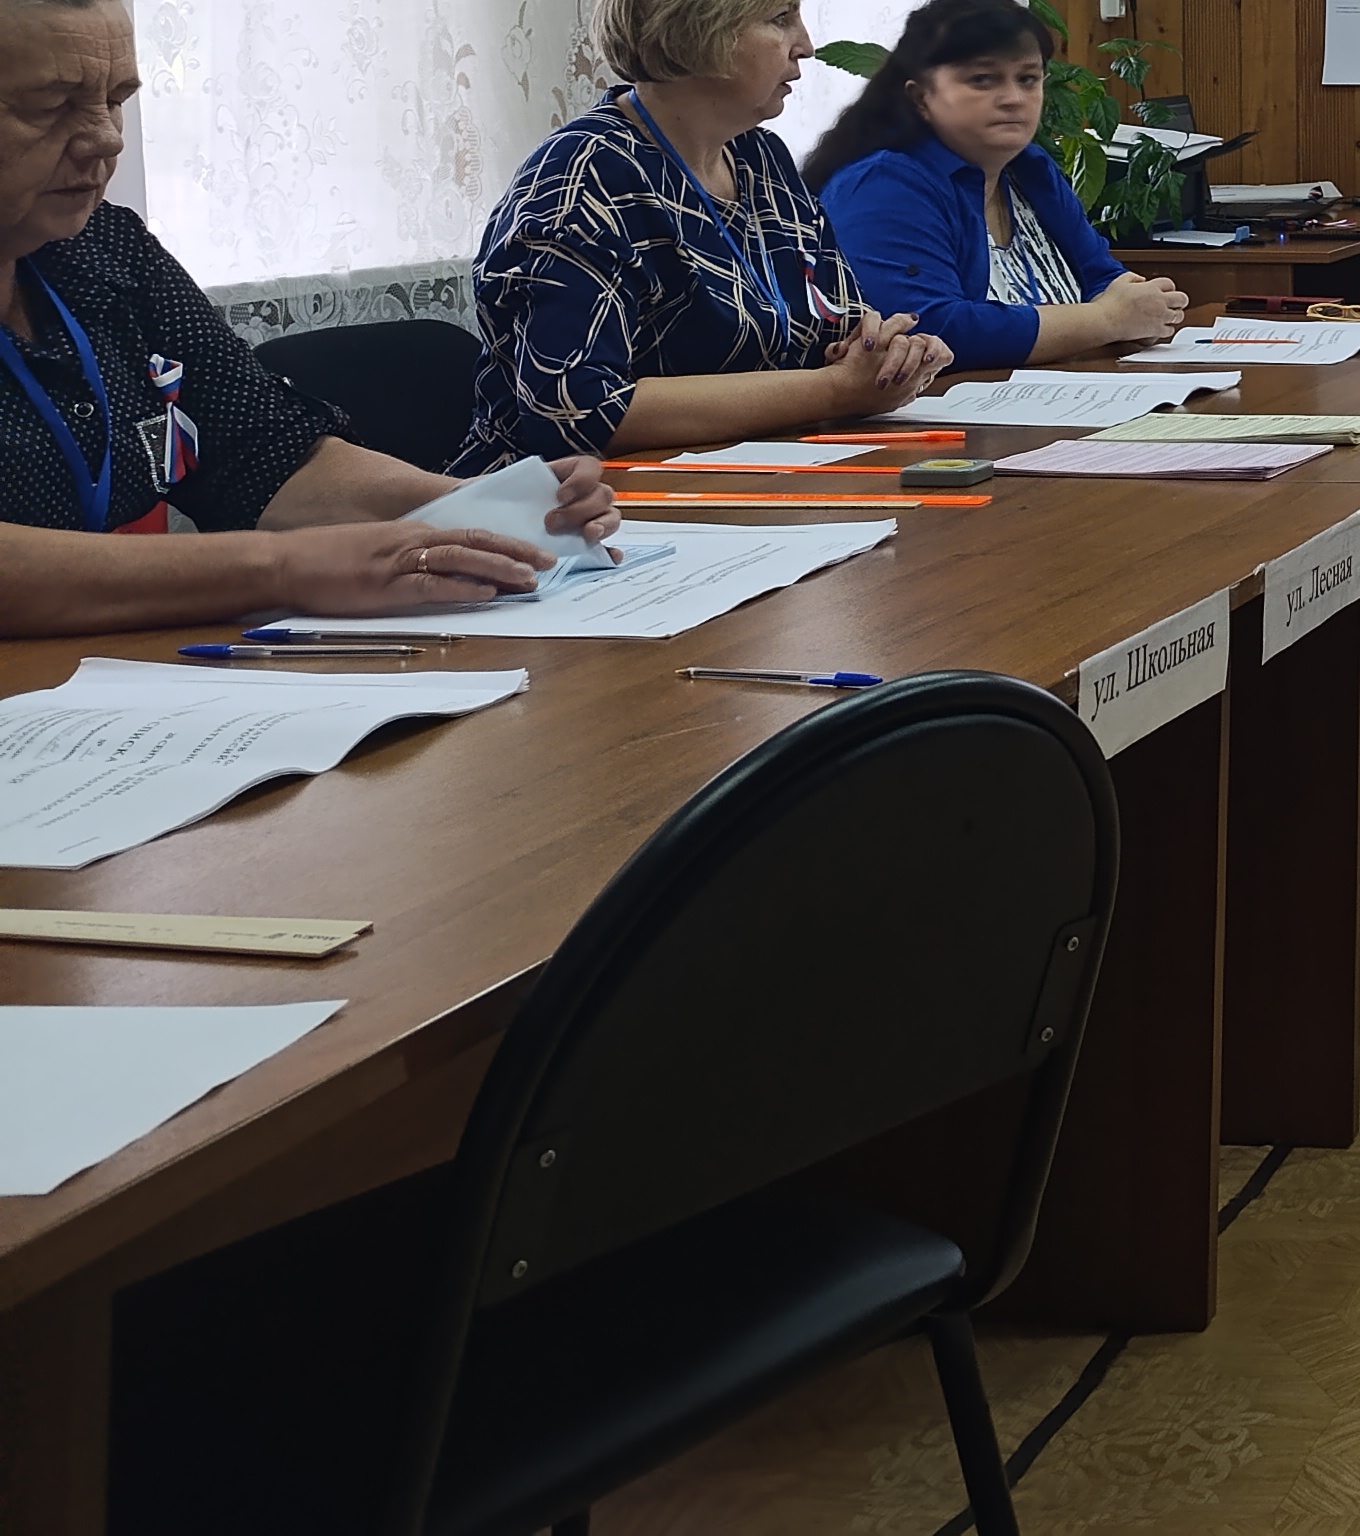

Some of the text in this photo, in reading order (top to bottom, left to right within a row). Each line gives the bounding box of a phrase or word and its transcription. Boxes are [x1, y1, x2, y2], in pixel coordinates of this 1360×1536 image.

[1286, 555, 1353, 627] ул. Лесная
[1091, 621, 1216, 722] ул. Школьная
